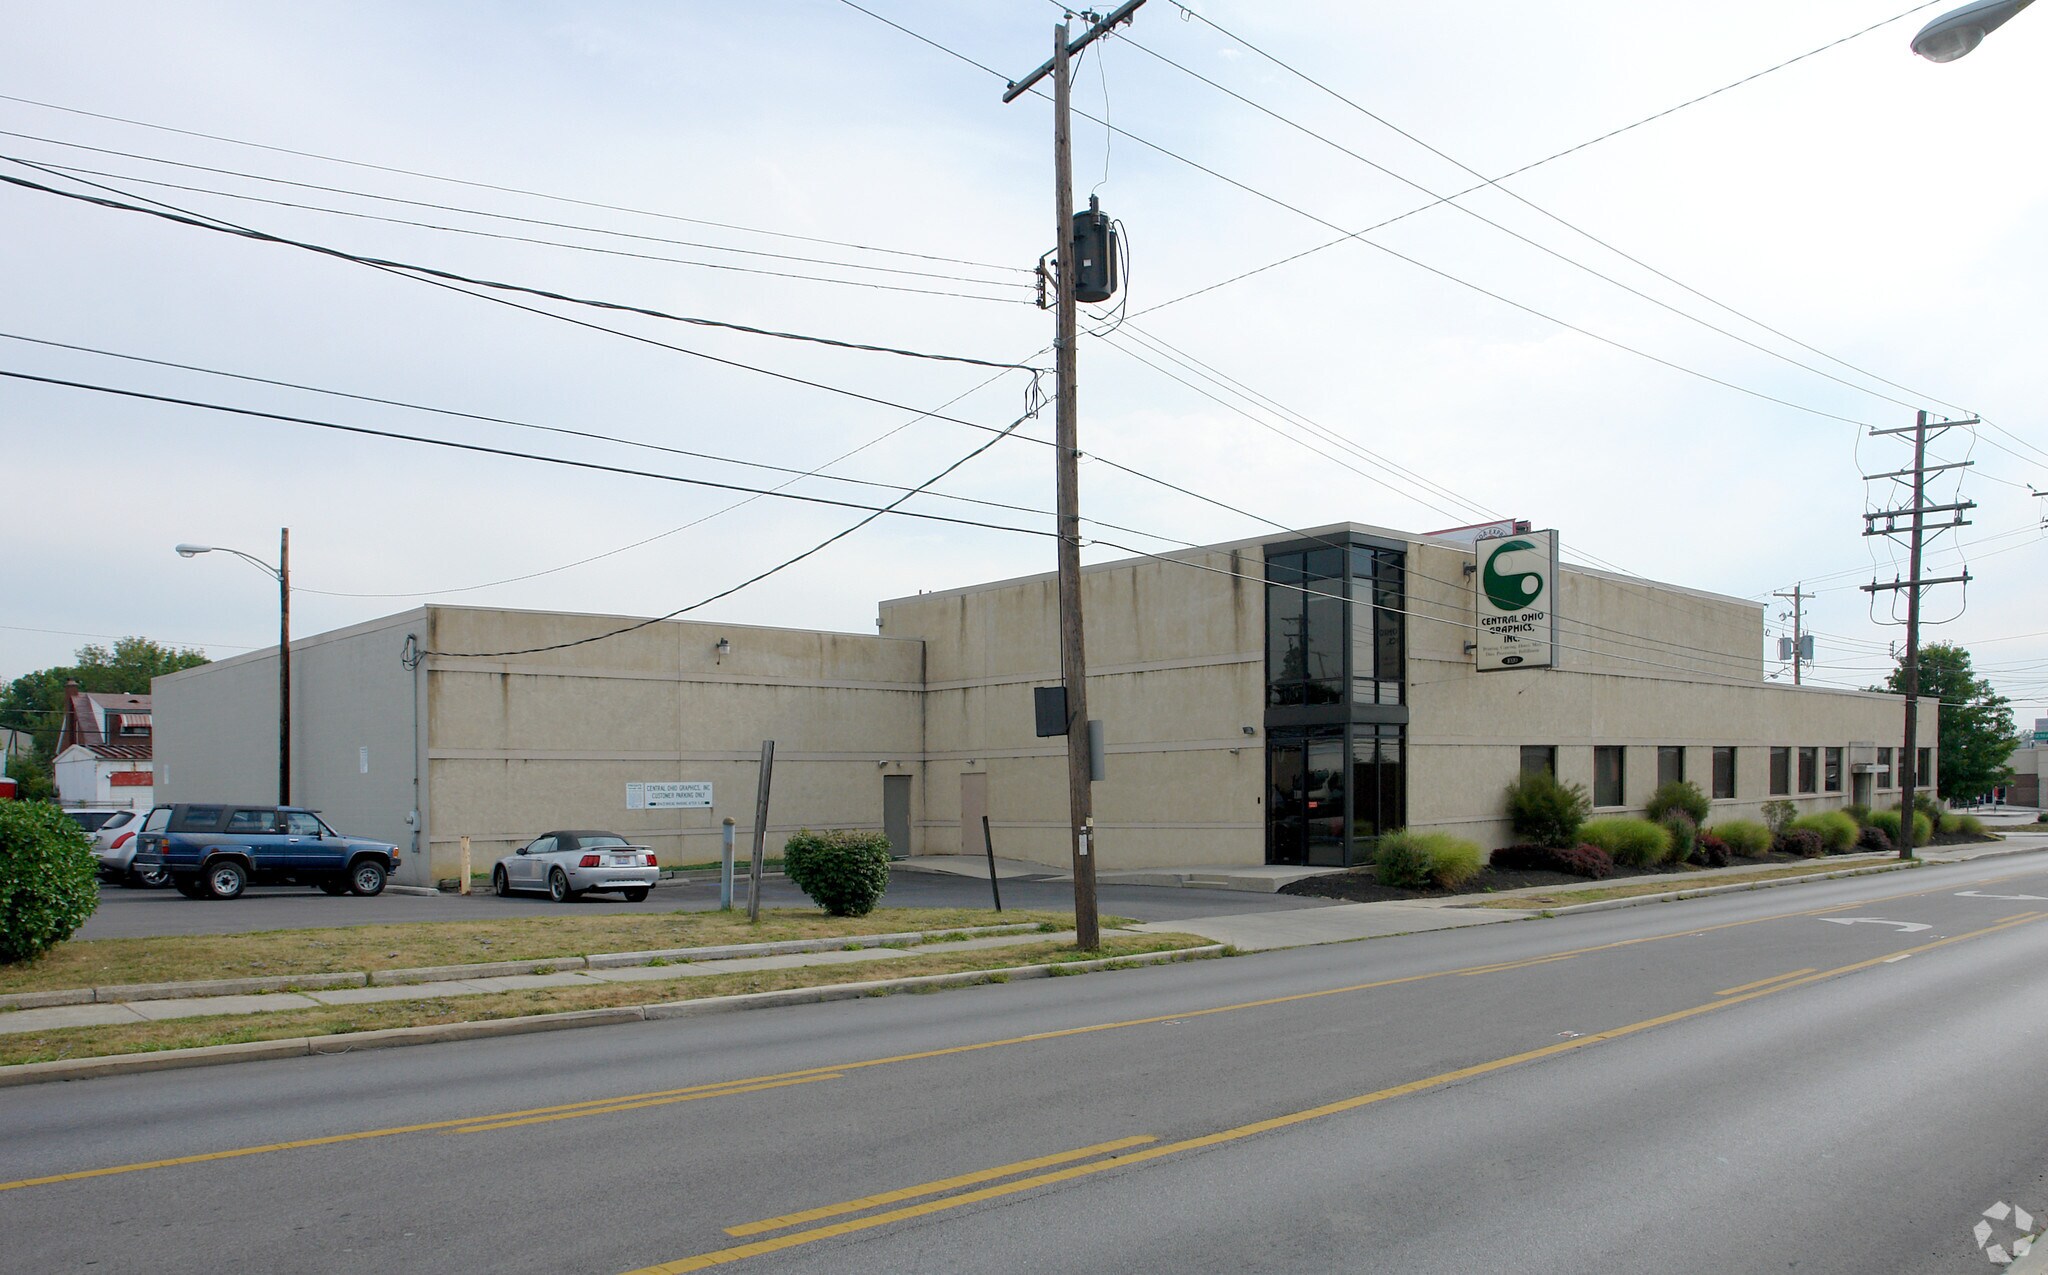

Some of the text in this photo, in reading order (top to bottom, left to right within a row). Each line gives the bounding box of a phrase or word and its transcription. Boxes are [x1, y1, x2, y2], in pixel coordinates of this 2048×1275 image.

[1481, 611, 1544, 626] CENTRAL OHIO
[1489, 622, 1535, 635] GRAPHICS,
